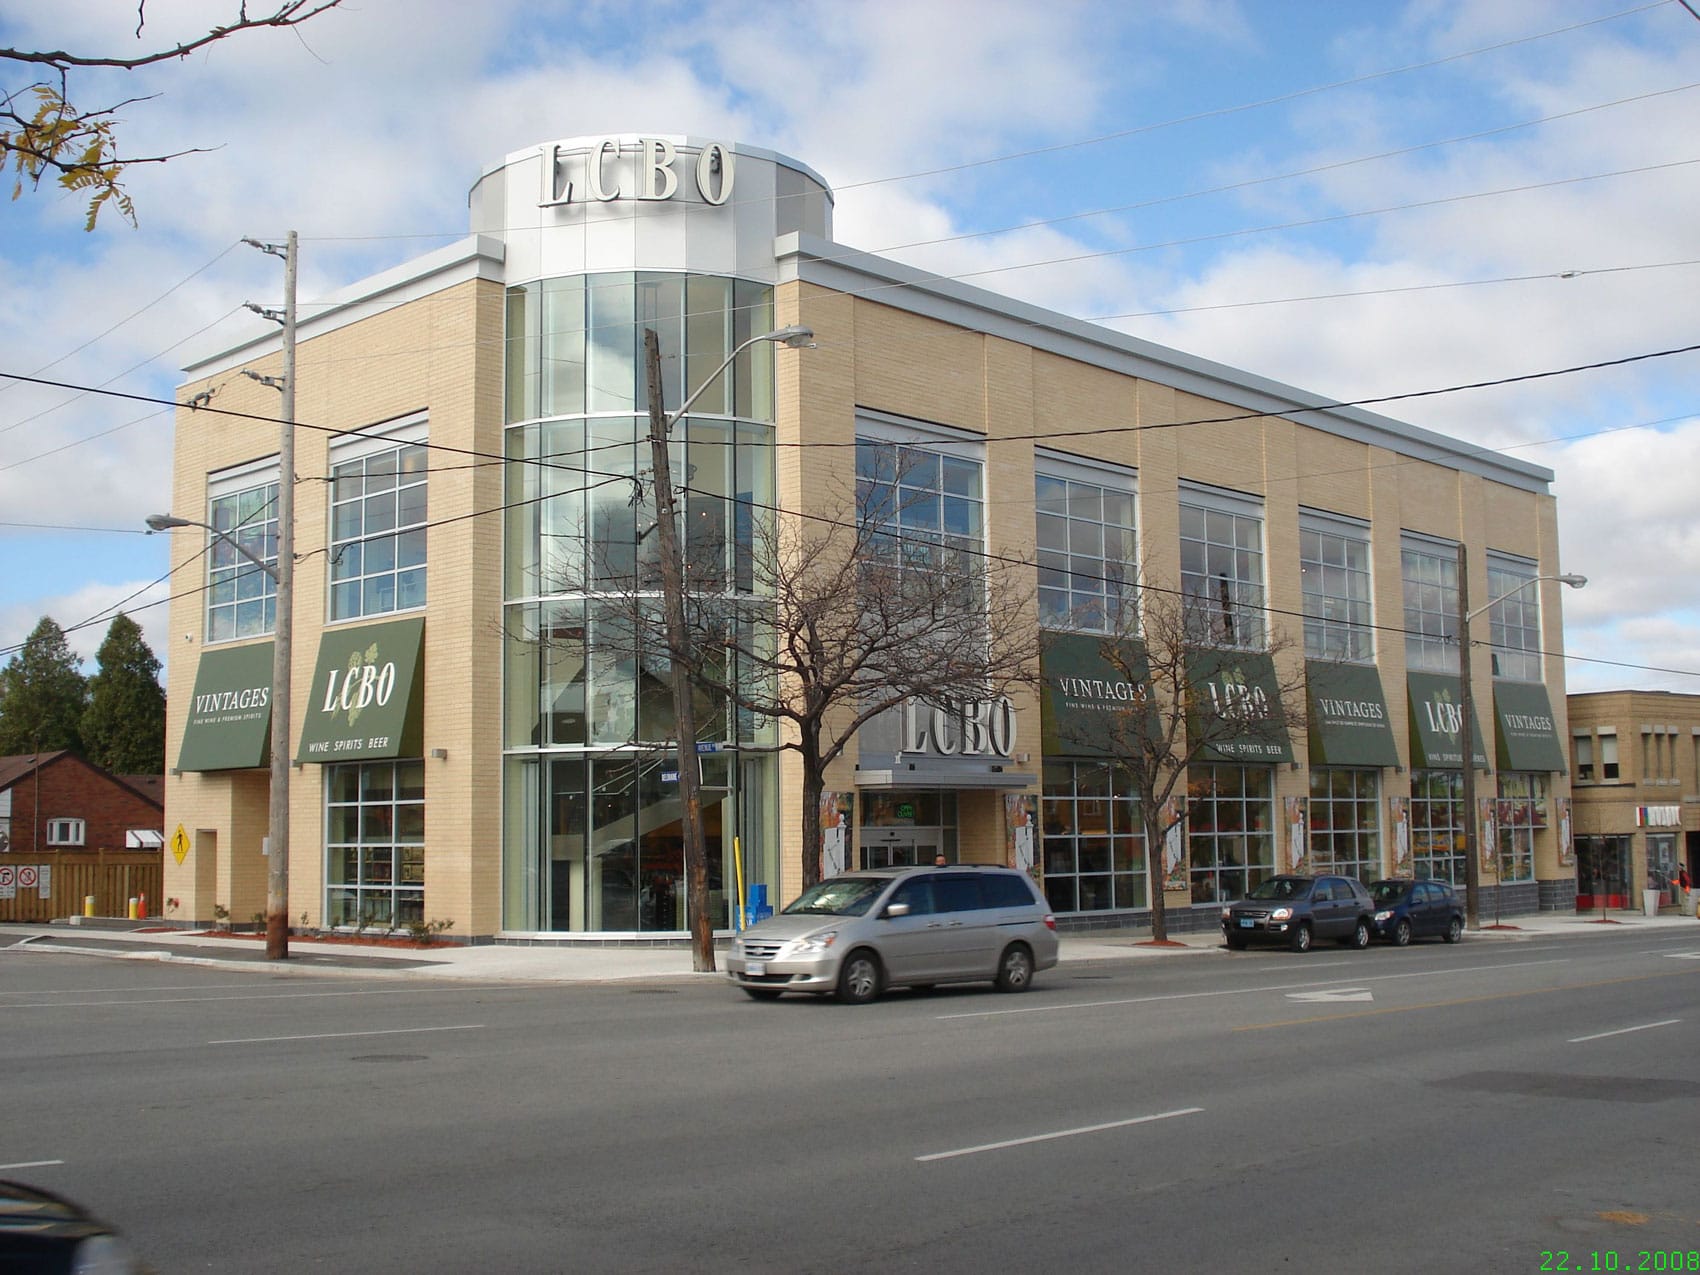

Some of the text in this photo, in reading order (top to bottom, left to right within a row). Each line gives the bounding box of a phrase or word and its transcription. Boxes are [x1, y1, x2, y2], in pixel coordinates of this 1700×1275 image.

[537, 138, 735, 207] LCBO
[321, 662, 395, 712] LCBO
[1060, 678, 1146, 701] VINTAGES
[196, 687, 269, 714] VINTAGES
[1208, 682, 1268, 719] LCBO
[1320, 698, 1383, 719] VINTAGES
[901, 695, 1017, 757] LCBO
[1505, 714, 1552, 731] VINTAGES
[309, 737, 389, 753] WINE SPIRITS BEER
[1216, 743, 1282, 755] WINE SPIRITS BEER
